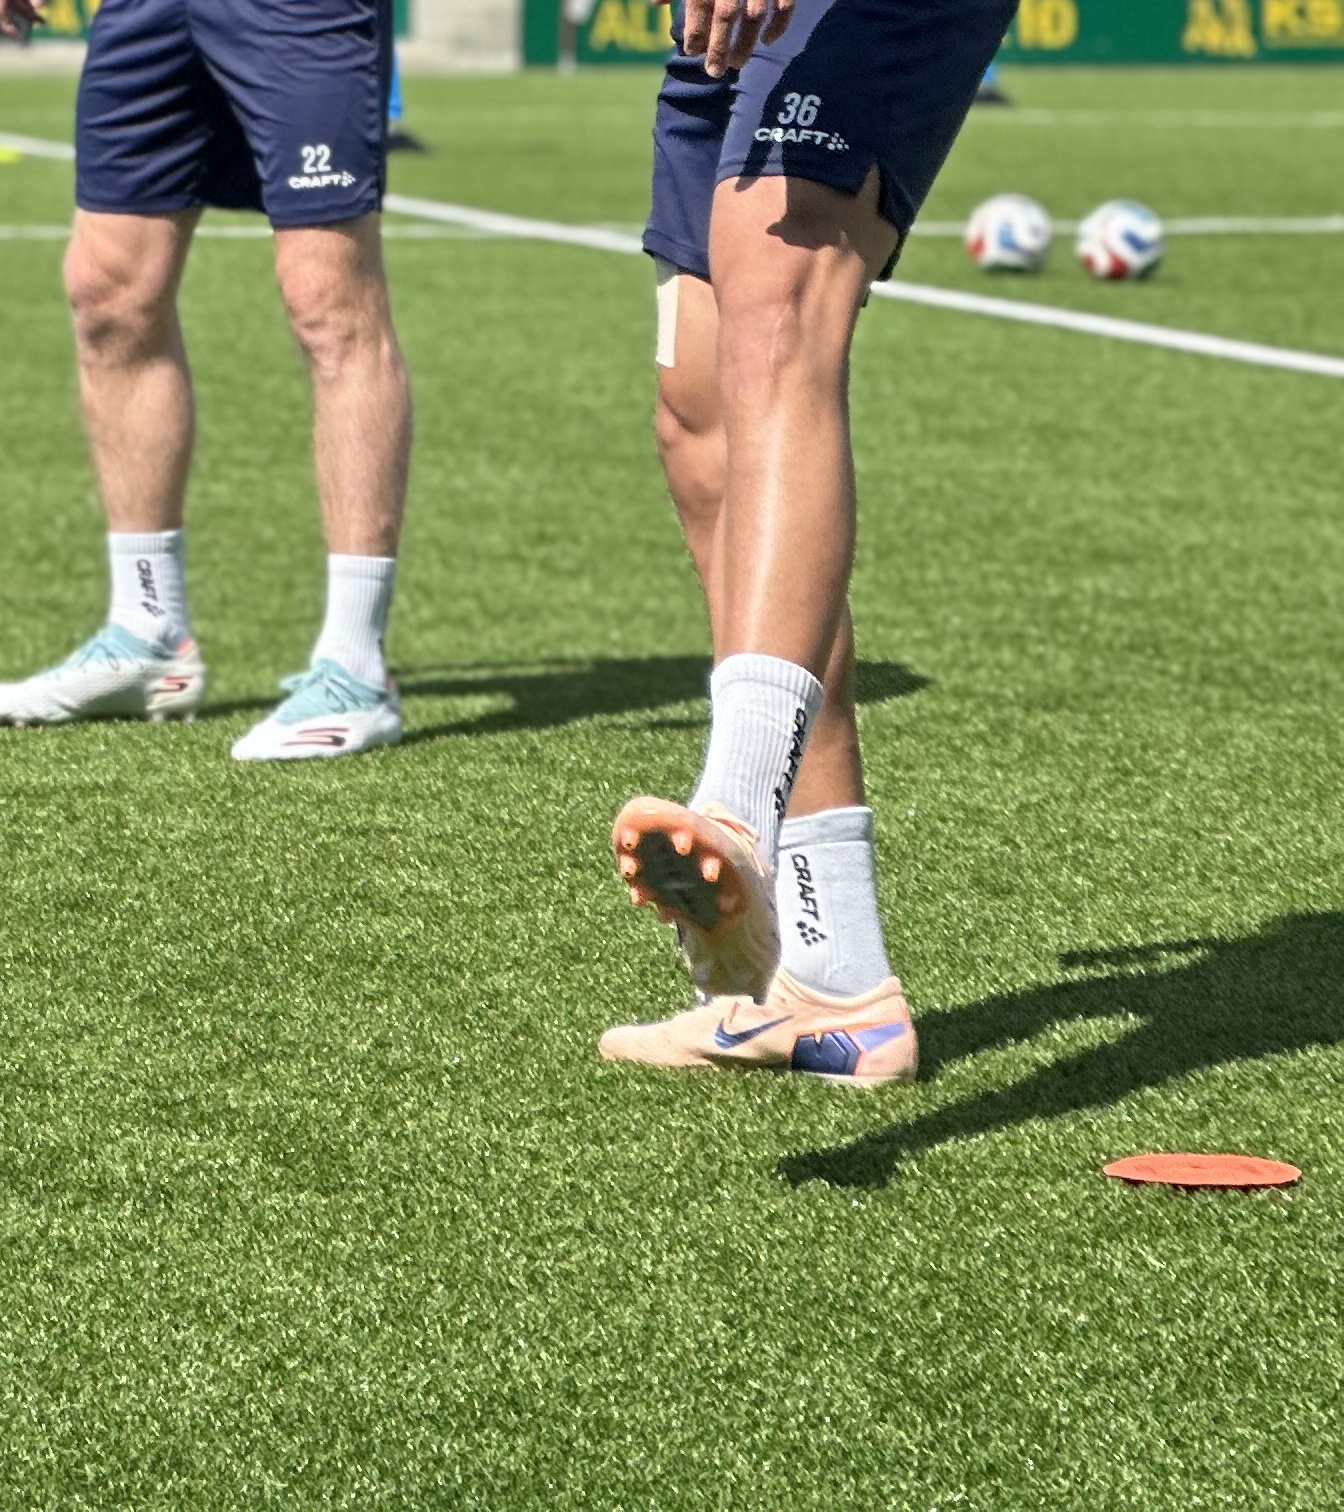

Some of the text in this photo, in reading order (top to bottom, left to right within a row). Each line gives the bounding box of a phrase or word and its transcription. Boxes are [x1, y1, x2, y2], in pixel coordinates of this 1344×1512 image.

[777, 91, 822, 127] 36
[754, 127, 830, 146] CRAFT
[301, 143, 332, 174] 22
[288, 174, 342, 189] CRAFT
[136, 558, 159, 602] CRAFT
[791, 852, 821, 922] CRAFT
